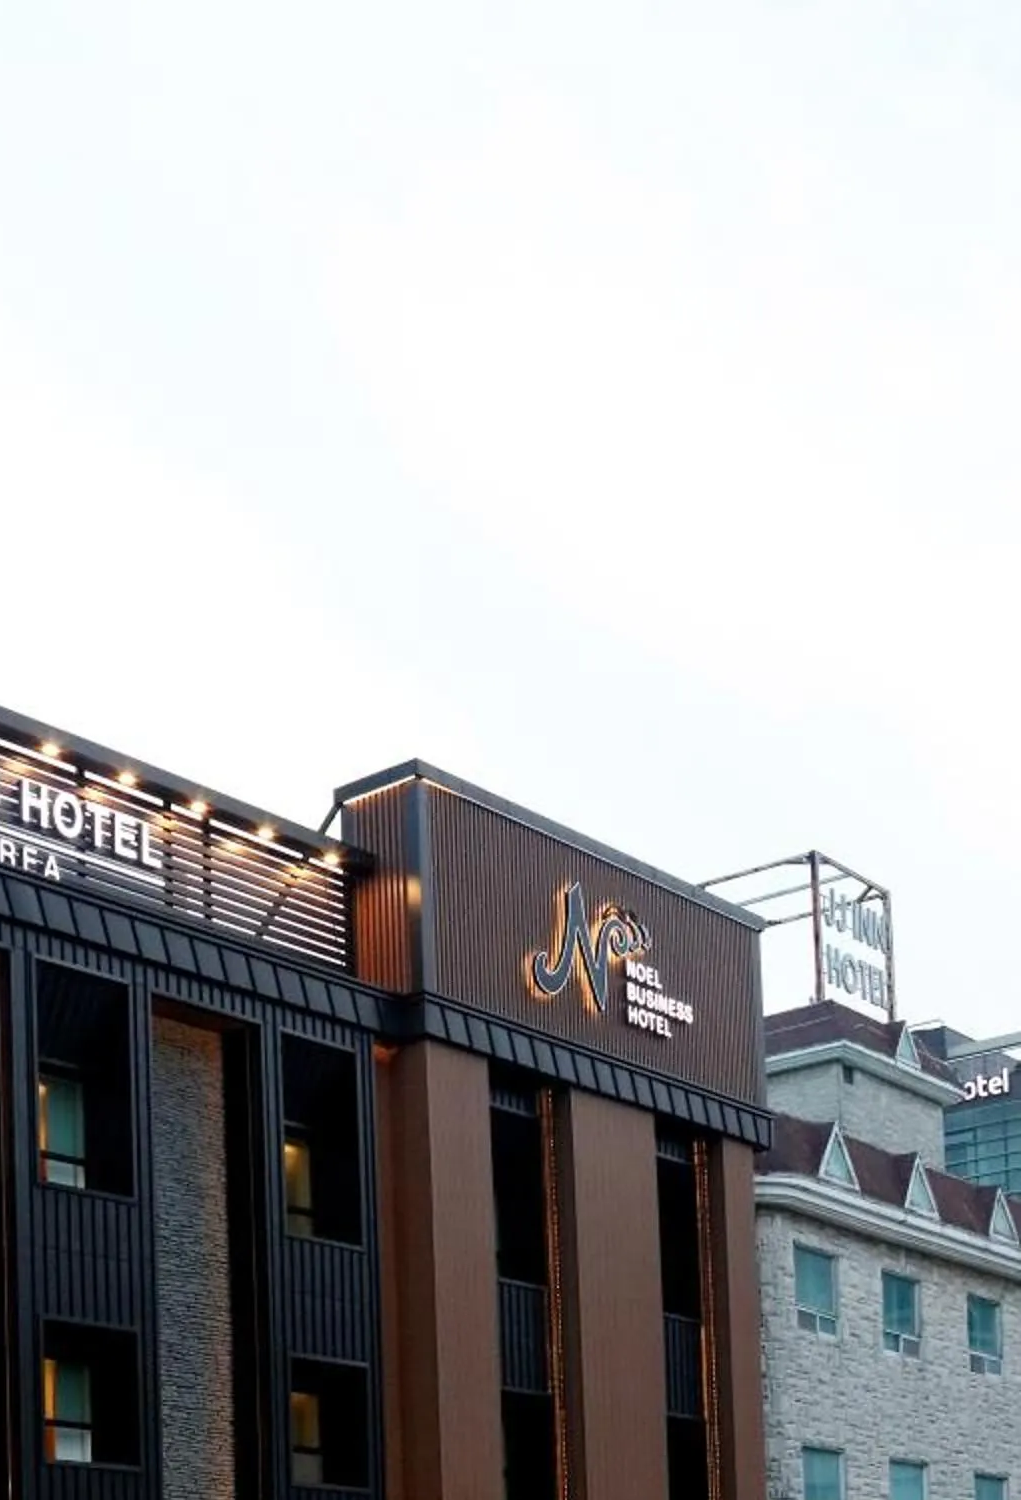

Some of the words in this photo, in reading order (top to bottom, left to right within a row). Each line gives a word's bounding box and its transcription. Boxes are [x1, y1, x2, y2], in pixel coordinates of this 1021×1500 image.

[20, 776, 163, 868] HOTEL
[625, 960, 663, 990] NOEL
[825, 943, 888, 1010] HOTEL
[626, 980, 694, 1025] BUSINESS
[627, 1004, 673, 1039] HOTEL
